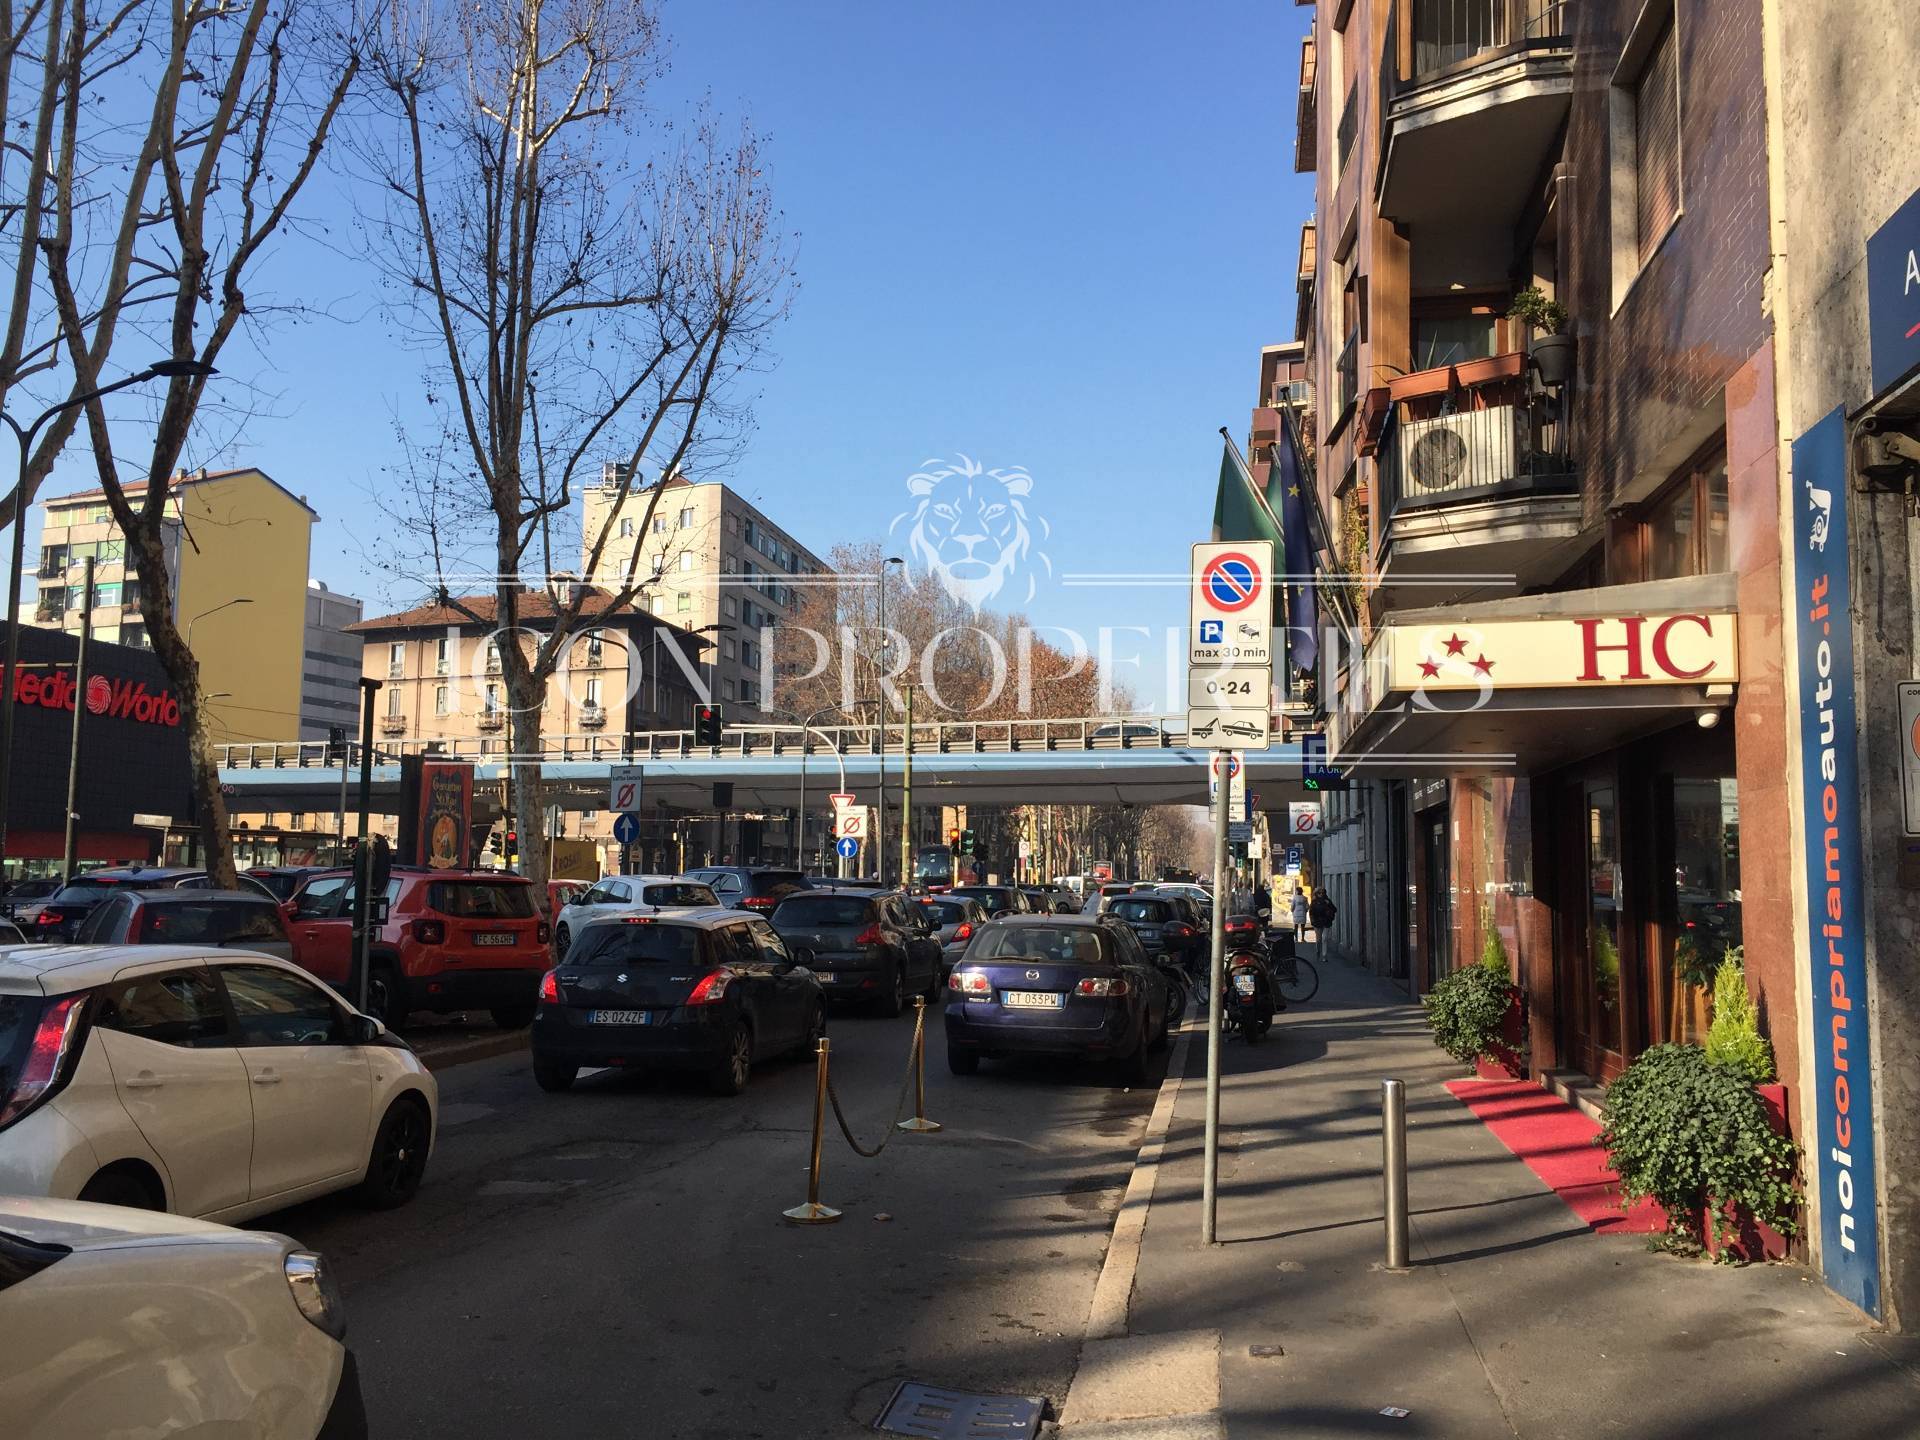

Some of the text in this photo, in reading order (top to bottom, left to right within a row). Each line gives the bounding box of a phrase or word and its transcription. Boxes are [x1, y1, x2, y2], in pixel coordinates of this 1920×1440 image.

[1204, 623, 1219, 640] P
[1194, 647, 1266, 658] max 30 min
[1574, 614, 1718, 681] HC
[1206, 681, 1251, 695] 0-24
[1289, 851, 1298, 863] P
[1810, 574, 1856, 1253] noicompriamoauto.it
[1009, 993, 1057, 1005] CT 033PW
[595, 1011, 644, 1024] ES 024ZF
